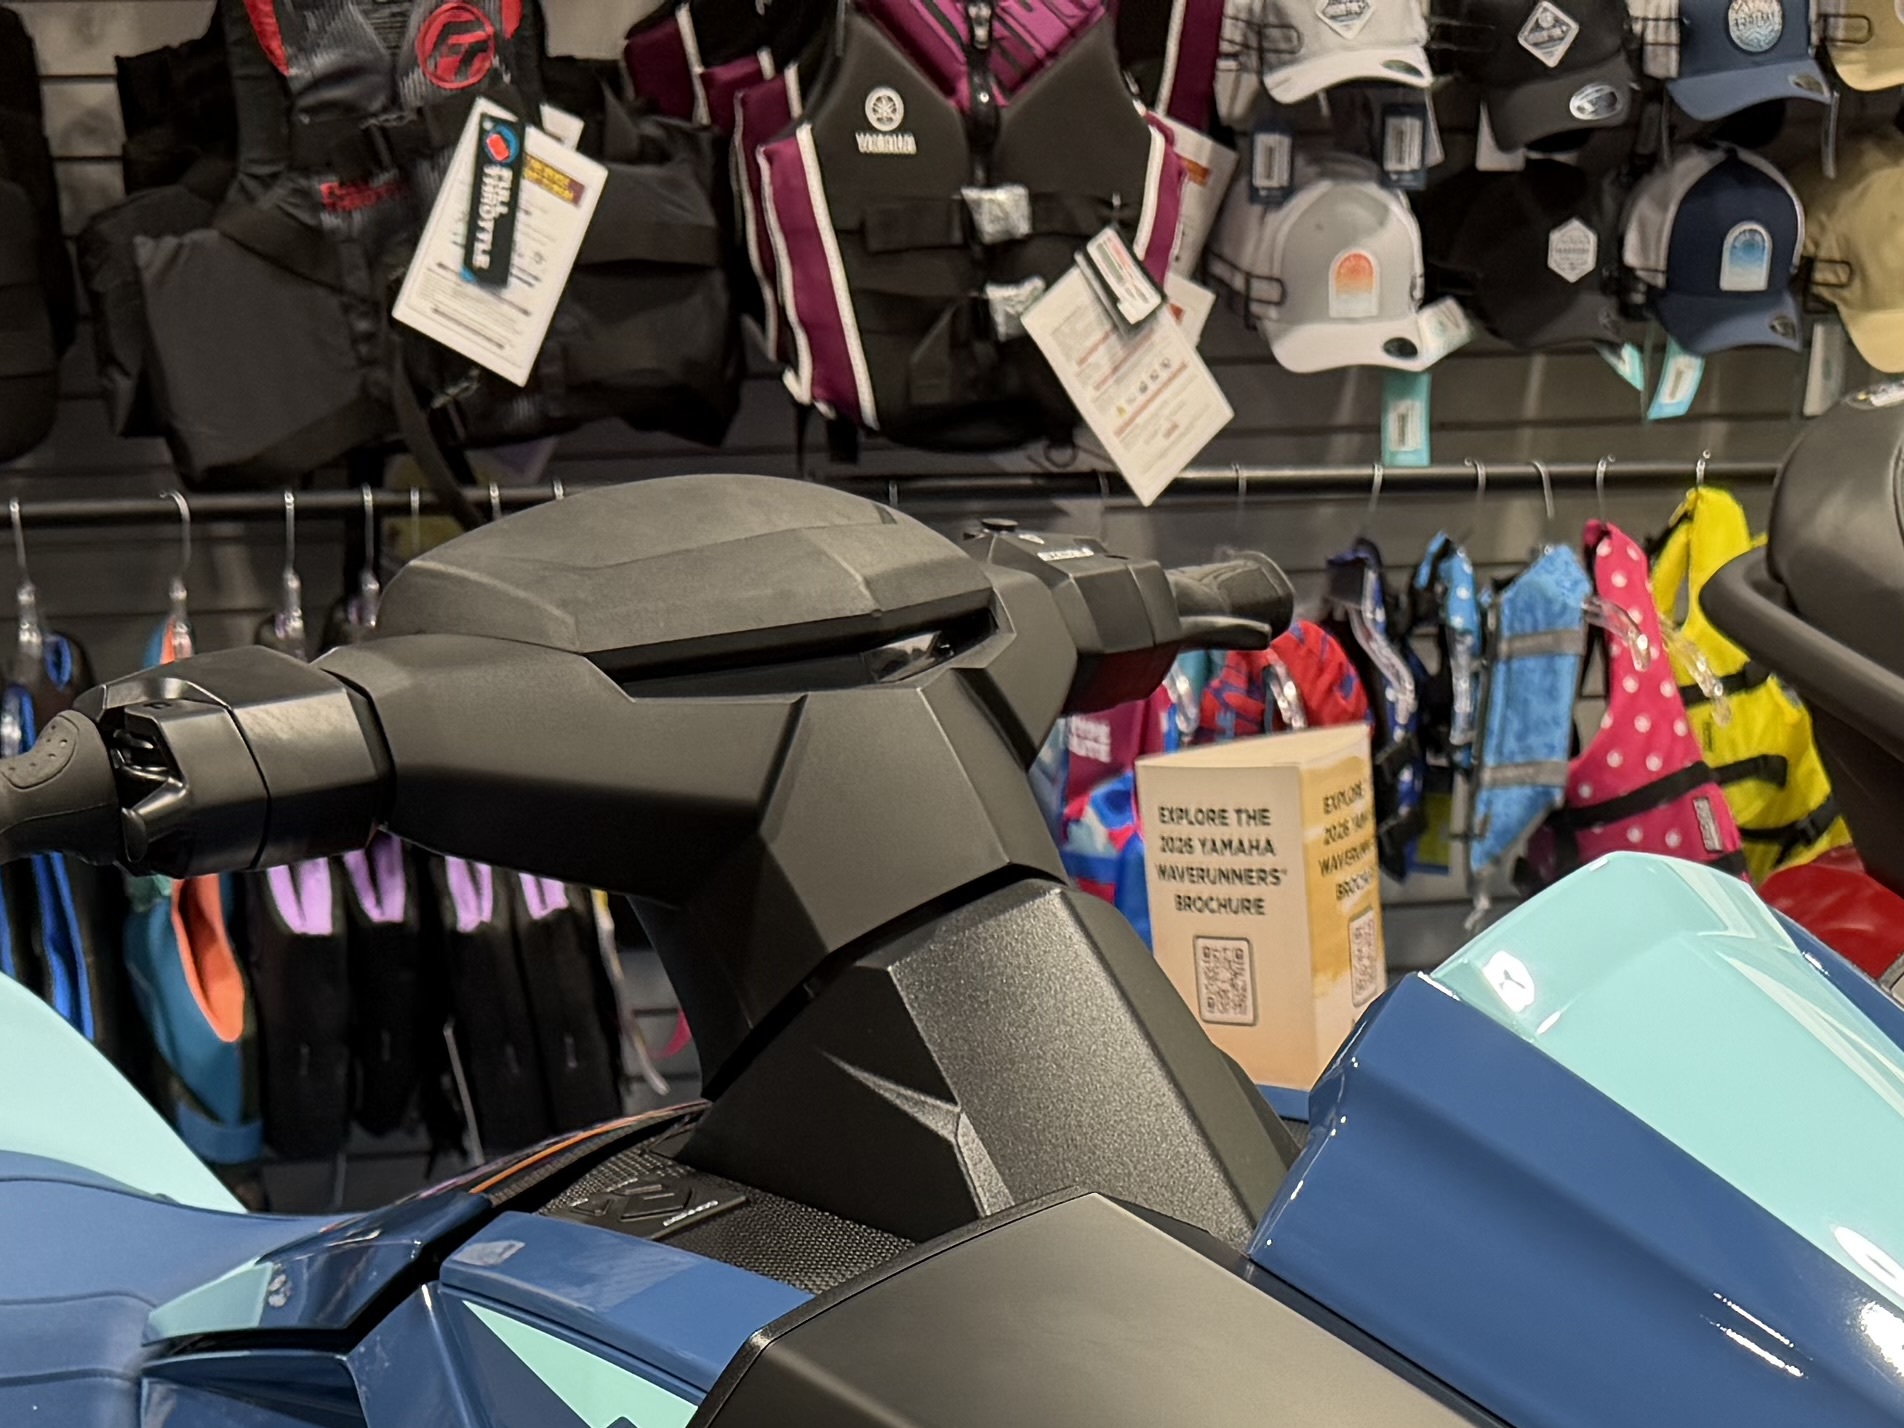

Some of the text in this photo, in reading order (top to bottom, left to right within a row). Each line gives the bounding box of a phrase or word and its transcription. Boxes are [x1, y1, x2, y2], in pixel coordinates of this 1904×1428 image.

[1158, 806, 1272, 827] EXPLORE THE
[1160, 835, 1277, 857] 2026 YAMAHA
[1174, 894, 1266, 916] BROCHURE
